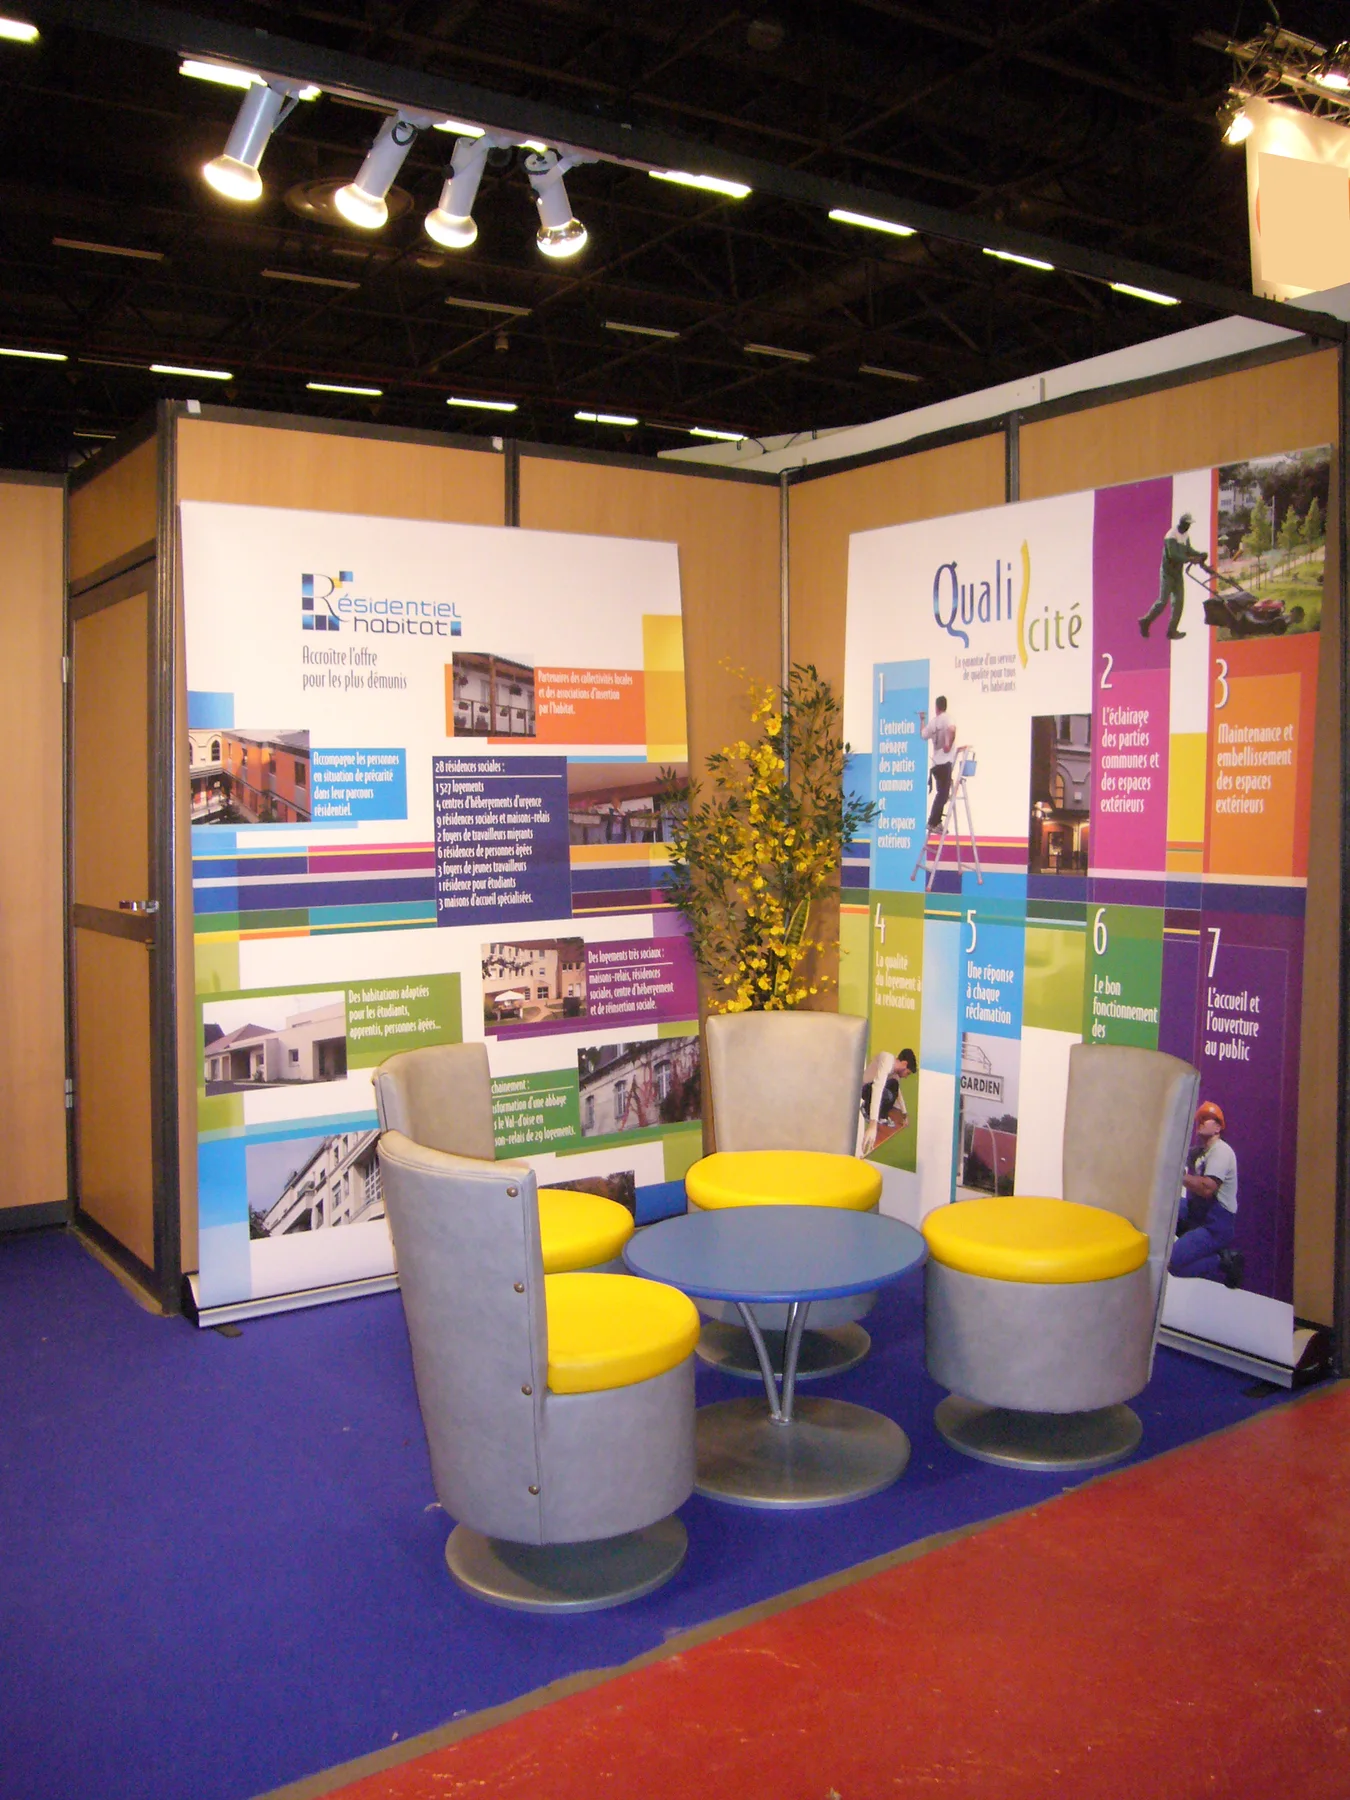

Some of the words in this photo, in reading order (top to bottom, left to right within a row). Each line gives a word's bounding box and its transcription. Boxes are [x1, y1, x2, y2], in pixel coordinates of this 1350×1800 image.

[302, 573, 461, 622] Résidentiel
[354, 617, 447, 636] habitat
[302, 645, 346, 665] Accroître
[350, 647, 377, 666] l'offre
[303, 673, 325, 691] pour
[328, 669, 341, 688] les
[345, 670, 364, 691] plus
[368, 672, 407, 689] démunis
[538, 670, 569, 683] Partenaires
[571, 671, 580, 684] des
[581, 672, 613, 685] collectivités
[614, 673, 632, 685] locales
[1100, 653, 1113, 689] 2
[538, 688, 545, 698] et
[546, 686, 555, 698] des
[556, 689, 589, 699] associations
[590, 687, 620, 700] d'insertion
[878, 673, 884, 703] 1
[1214, 658, 1229, 709] 3
[539, 703, 548, 716] par
[1102, 706, 1149, 728] L'éclairage
[880, 719, 915, 736] L'entretien
[1218, 723, 1281, 744] Maintenance
[1284, 724, 1294, 742] et
[879, 739, 908, 756] ménager
[1102, 728, 1116, 748] des
[1118, 730, 1150, 750] parties
[313, 751, 355, 767] Accompagne
[356, 751, 366, 765] les
[367, 754, 399, 767] personnes
[435, 761, 444, 772] 28
[445, 759, 476, 772] résidences
[477, 759, 501, 772] sociales
[879, 757, 890, 773] des
[892, 757, 915, 775] parties
[1102, 754, 1147, 769] communes
[1150, 752, 1160, 768] et
[1217, 746, 1292, 767] embellissement
[313, 772, 322, 782] en
[324, 769, 353, 782] situation
[355, 768, 363, 781] de
[365, 769, 393, 784] précarité
[879, 779, 913, 792] communes
[1101, 772, 1116, 791] des
[1118, 775, 1151, 794] espaces
[1216, 770, 1233, 790] des
[1236, 774, 1272, 793] espaces
[314, 785, 329, 799] dans
[331, 785, 345, 799] leur
[346, 788, 374, 801] parcours
[452, 779, 484, 794] logements
[314, 802, 352, 816] résidentiel.
[436, 800, 441, 811] 4
[442, 797, 463, 809] centres
[464, 795, 512, 810] d'hébergements
[514, 795, 542, 809] d'urgence
[879, 797, 886, 810] et
[1100, 794, 1145, 813] extérieurs
[1215, 794, 1264, 814] extérieurs
[436, 817, 441, 828] 9
[442, 812, 474, 825] résidences
[475, 812, 498, 825] sociales
[500, 813, 506, 824] et
[507, 811, 550, 823] maisons-relais
[878, 813, 890, 829] des
[891, 816, 916, 833] espaces
[437, 833, 442, 842] 2
[443, 829, 462, 844] foyers
[463, 828, 471, 841] de
[472, 827, 506, 840] travailleurs
[507, 828, 534, 841] migrants
[878, 834, 911, 849] extérieurs
[438, 847, 442, 858] 6
[444, 845, 475, 858] résidences
[476, 844, 484, 856] de
[484, 846, 514, 859] personnes
[516, 843, 532, 857] âgées
[438, 866, 442, 878] 3
[443, 862, 462, 877] foyers
[464, 861, 471, 874] de
[472, 861, 492, 876] jeunes
[493, 859, 527, 872] travailleurs
[443, 878, 471, 891] résidence
[472, 880, 486, 892] pour
[488, 876, 516, 889] étudiants
[439, 899, 444, 910] 3
[444, 895, 469, 908] maisons
[470, 893, 496, 906] d'accueil
[497, 891, 534, 907] spécialisées.
[875, 903, 885, 944] 4
[966, 910, 976, 954] 5
[1093, 908, 1107, 955] 6
[588, 950, 598, 964] Des
[600, 950, 628, 964] logements
[628, 948, 640, 960] très
[640, 946, 661, 959] sociaux
[876, 951, 884, 967] La
[885, 953, 908, 971] qualité
[1208, 928, 1220, 978] 7
[588, 967, 631, 984] maisons-relais,
[632, 967, 660, 980] résidences
[876, 970, 884, 986] du
[886, 972, 916, 990] logement
[917, 976, 922, 992] à
[967, 961, 982, 979] Une
[984, 963, 1014, 983] réponse
[348, 989, 360, 1004] Des
[362, 988, 400, 1002] habitations
[400, 985, 429, 1000] adaptées
[590, 986, 613, 1000] sociales,
[614, 986, 630, 998] centre
[632, 982, 674, 996] d'hébergement
[966, 982, 972, 994] à
[973, 984, 1000, 1004] chaque
[1094, 974, 1104, 994] Le
[1105, 975, 1121, 996] bon
[590, 1005, 596, 1016] et
[598, 1002, 604, 1014] de
[606, 1000, 635, 1014] réinsertion
[875, 988, 882, 1005] la
[883, 990, 915, 1010] relocation
[1208, 987, 1247, 1011] L'accueil
[1250, 995, 1260, 1013] et
[349, 1010, 365, 1023] pour
[366, 1005, 376, 1019] les
[376, 1004, 410, 1018] étudiants,
[966, 1003, 1011, 1024] réclamation
[1093, 996, 1158, 1023] fonctionnement
[349, 1023, 382, 1040] apprentis,
[384, 1022, 416, 1037] personnes
[1092, 1018, 1106, 1038] des
[1206, 1010, 1260, 1037] l'ouverture
[1204, 1040, 1217, 1056] au
[1218, 1038, 1250, 1061] public
[960, 1076, 1000, 1095] GARDIEN
[528, 1096, 544, 1109] d'une
[545, 1093, 566, 1107] abbaye
[536, 1114, 544, 1125] en
[526, 1129, 533, 1142] de
[535, 1131, 543, 1142] 29
